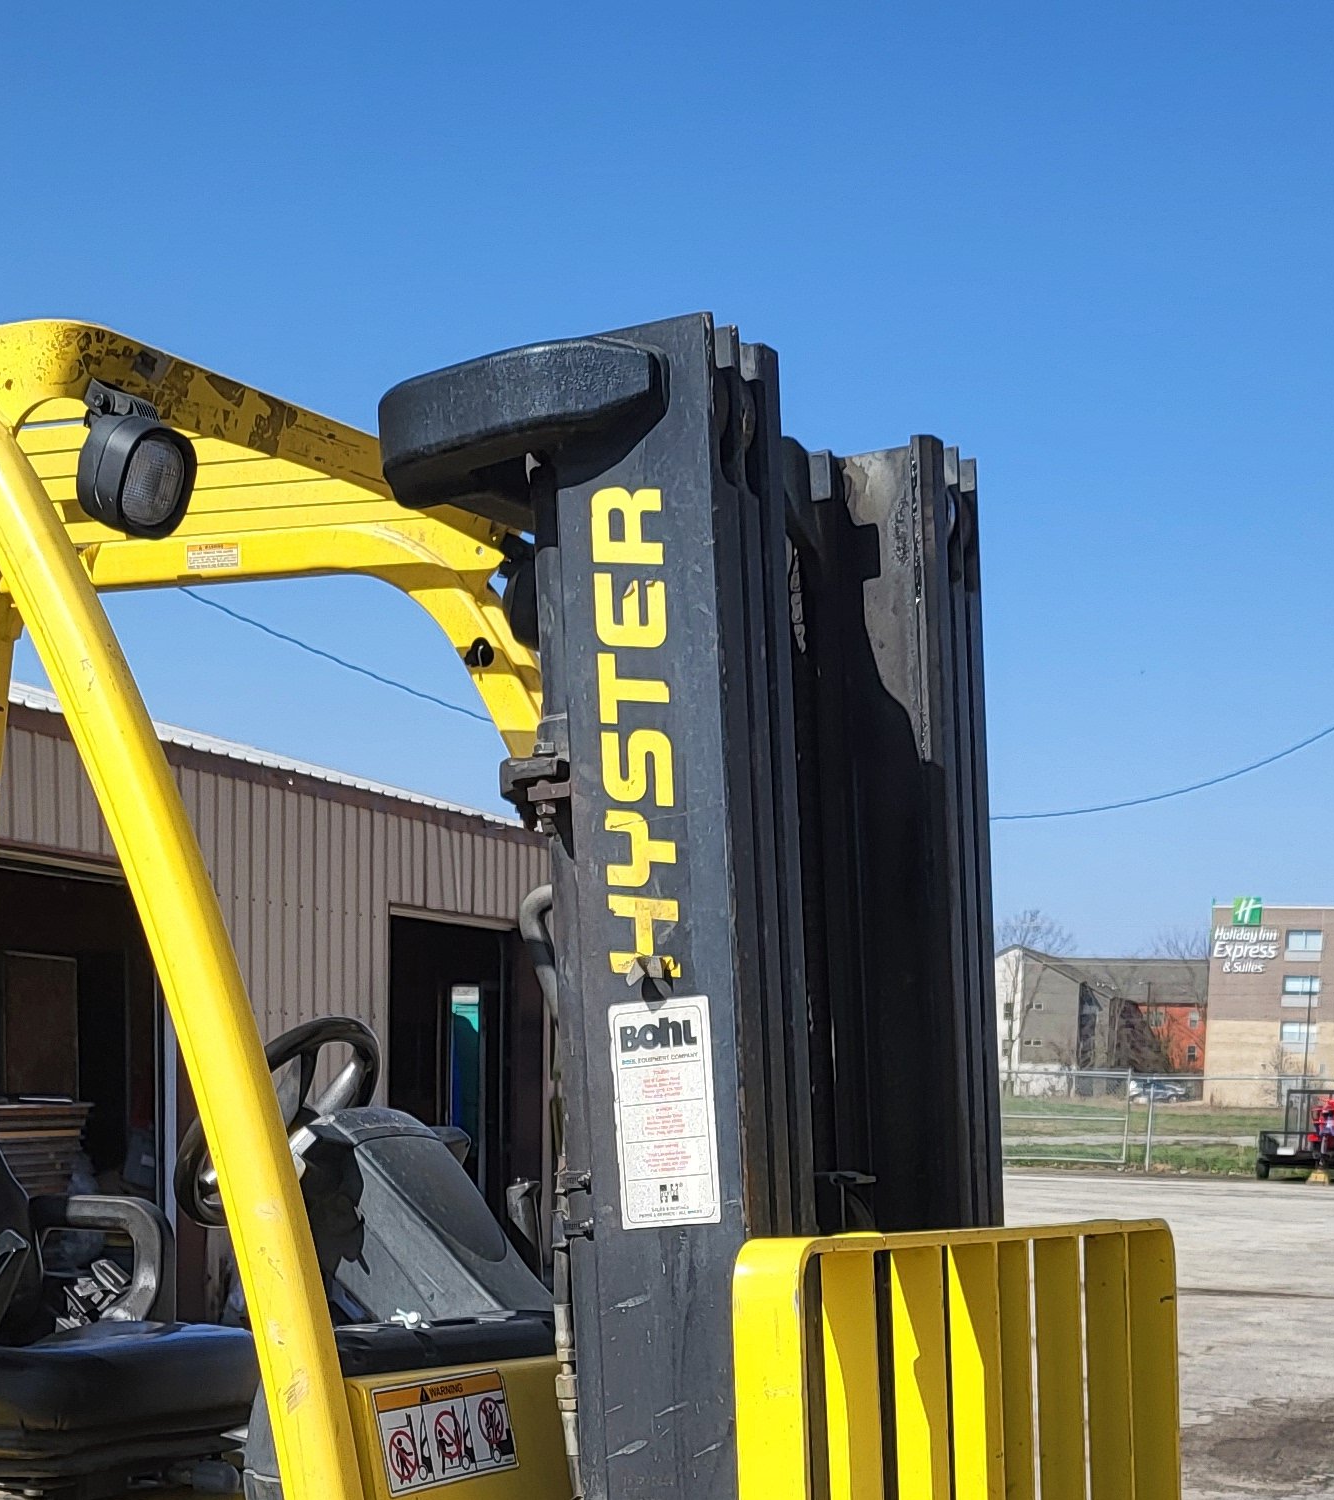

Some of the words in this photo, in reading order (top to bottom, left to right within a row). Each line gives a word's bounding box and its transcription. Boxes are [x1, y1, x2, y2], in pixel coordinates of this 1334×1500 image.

[591, 486, 681, 978] HYSTER
[1214, 926, 1257, 943] Holiday
[1258, 926, 1278, 940] Inn
[1213, 941, 1278, 961] Express
[1222, 961, 1231, 973] &
[1233, 961, 1264, 973] Suites
[670, 1051, 699, 1060] COMPANY
[429, 1382, 464, 1398] WARNING
